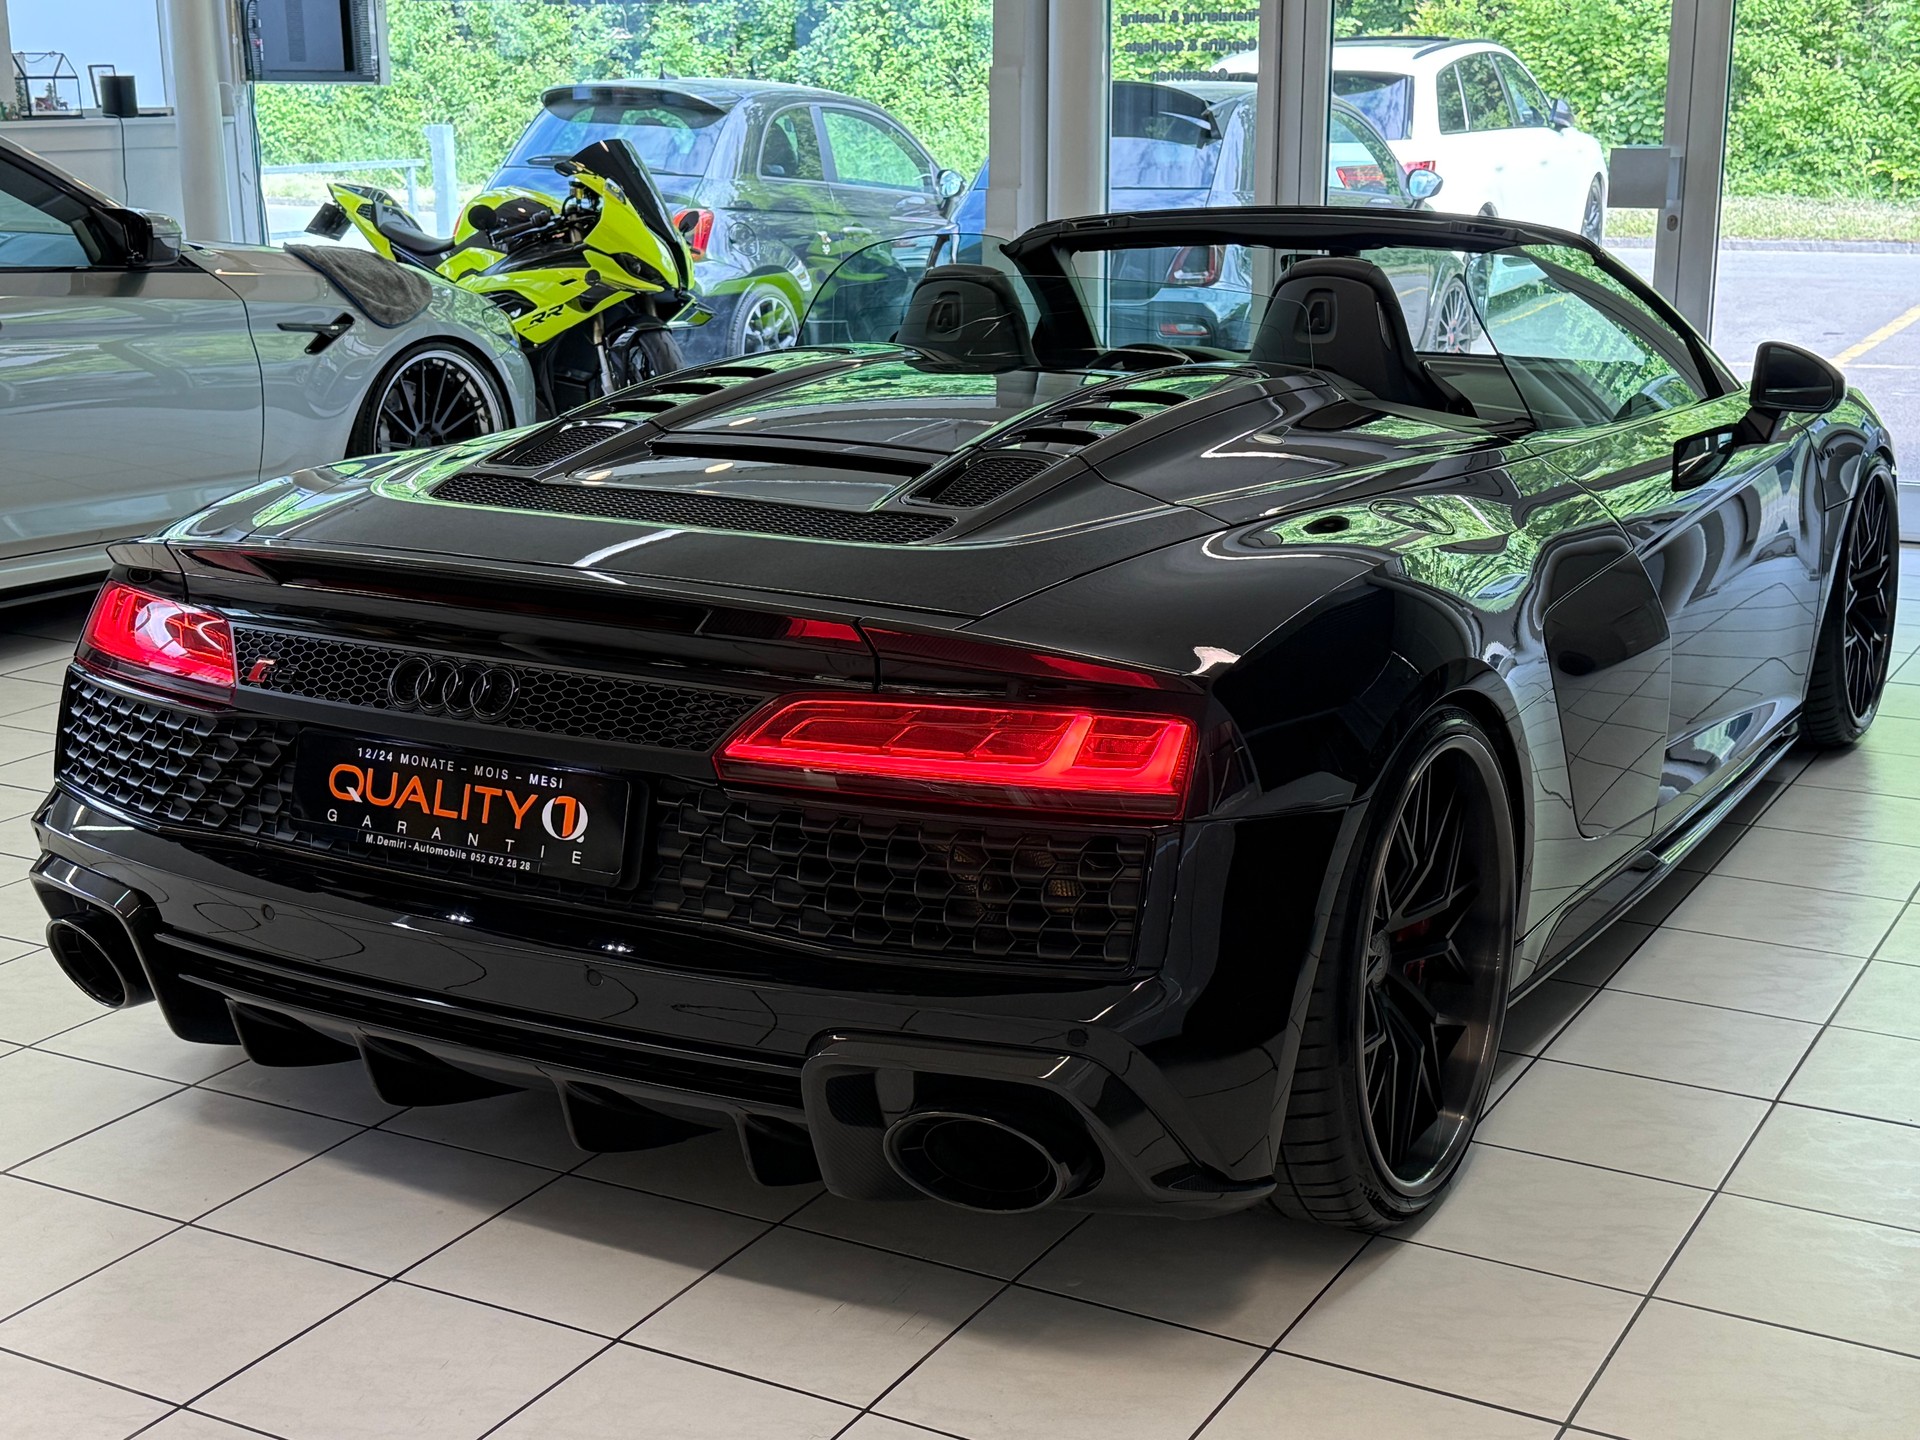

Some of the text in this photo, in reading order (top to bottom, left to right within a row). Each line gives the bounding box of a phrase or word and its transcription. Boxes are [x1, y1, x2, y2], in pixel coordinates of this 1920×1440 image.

[529, 304, 564, 325] RR
[247, 659, 296, 684] R8
[357, 747, 393, 763] 12/24
[400, 753, 455, 772] MONATE
[473, 765, 509, 780] MOIS
[529, 773, 563, 789] MESI
[328, 763, 539, 830] QUALITY
[326, 808, 582, 865] GARANTIE
[470, 852, 486, 863] 052
[488, 855, 504, 866] 672
[506, 858, 518, 869] 28
[519, 860, 531, 871] 28
